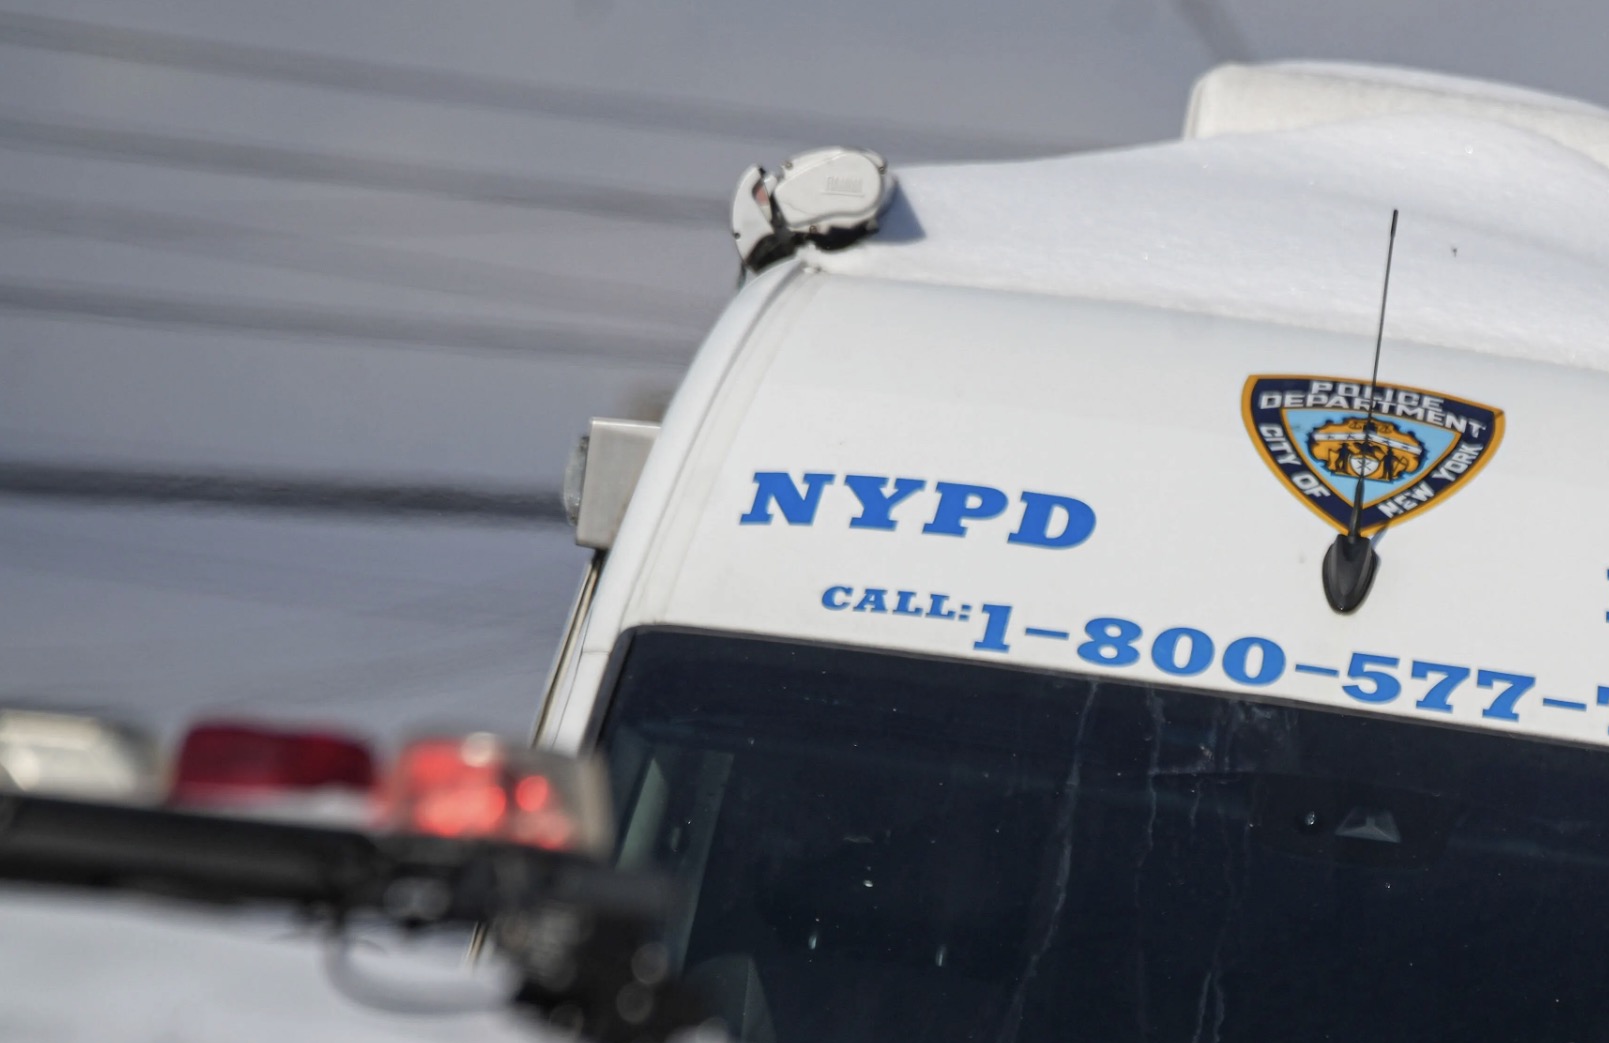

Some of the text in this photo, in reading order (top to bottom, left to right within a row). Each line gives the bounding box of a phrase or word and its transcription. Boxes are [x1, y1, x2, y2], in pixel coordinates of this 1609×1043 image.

[1259, 391, 1487, 438] DEPARTMENT
[1311, 381, 1445, 412] POLICE
[1259, 423, 1331, 500] CITY OF
[1377, 443, 1484, 519] NEW YORK
[739, 472, 1098, 550] NYPD
[820, 585, 972, 622] CALL:
